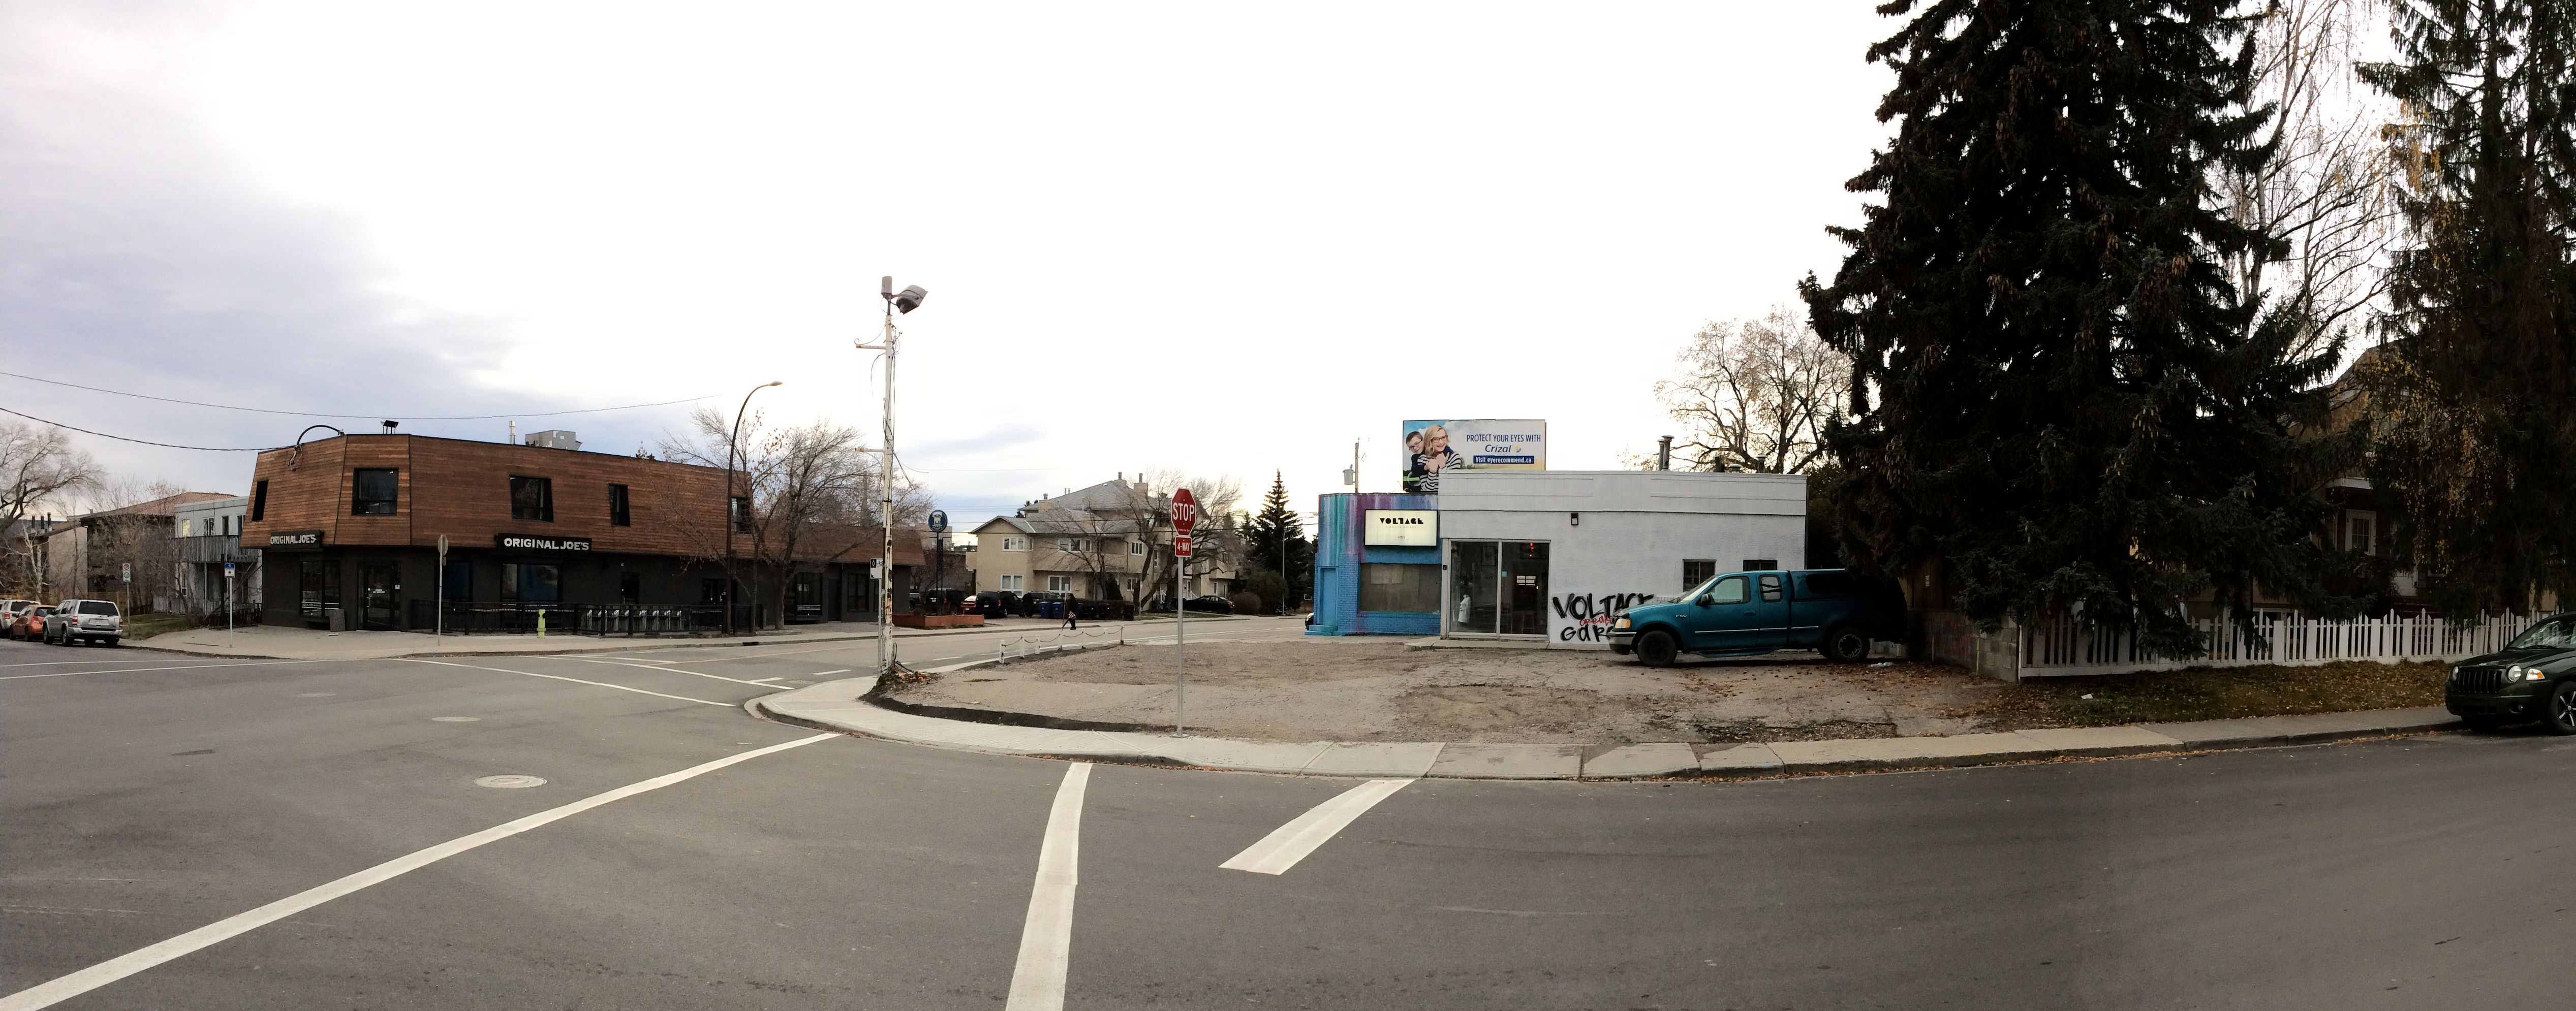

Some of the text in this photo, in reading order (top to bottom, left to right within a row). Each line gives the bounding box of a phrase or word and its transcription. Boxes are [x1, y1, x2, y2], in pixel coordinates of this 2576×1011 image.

[1485, 445, 1512, 453] Crizal
[1172, 502, 1195, 521] STOP
[270, 534, 317, 545] ORIGINAL JOE'S
[504, 538, 589, 551] ORIGINAL JOE'S
[1177, 542, 1190, 551] 4-WAY
